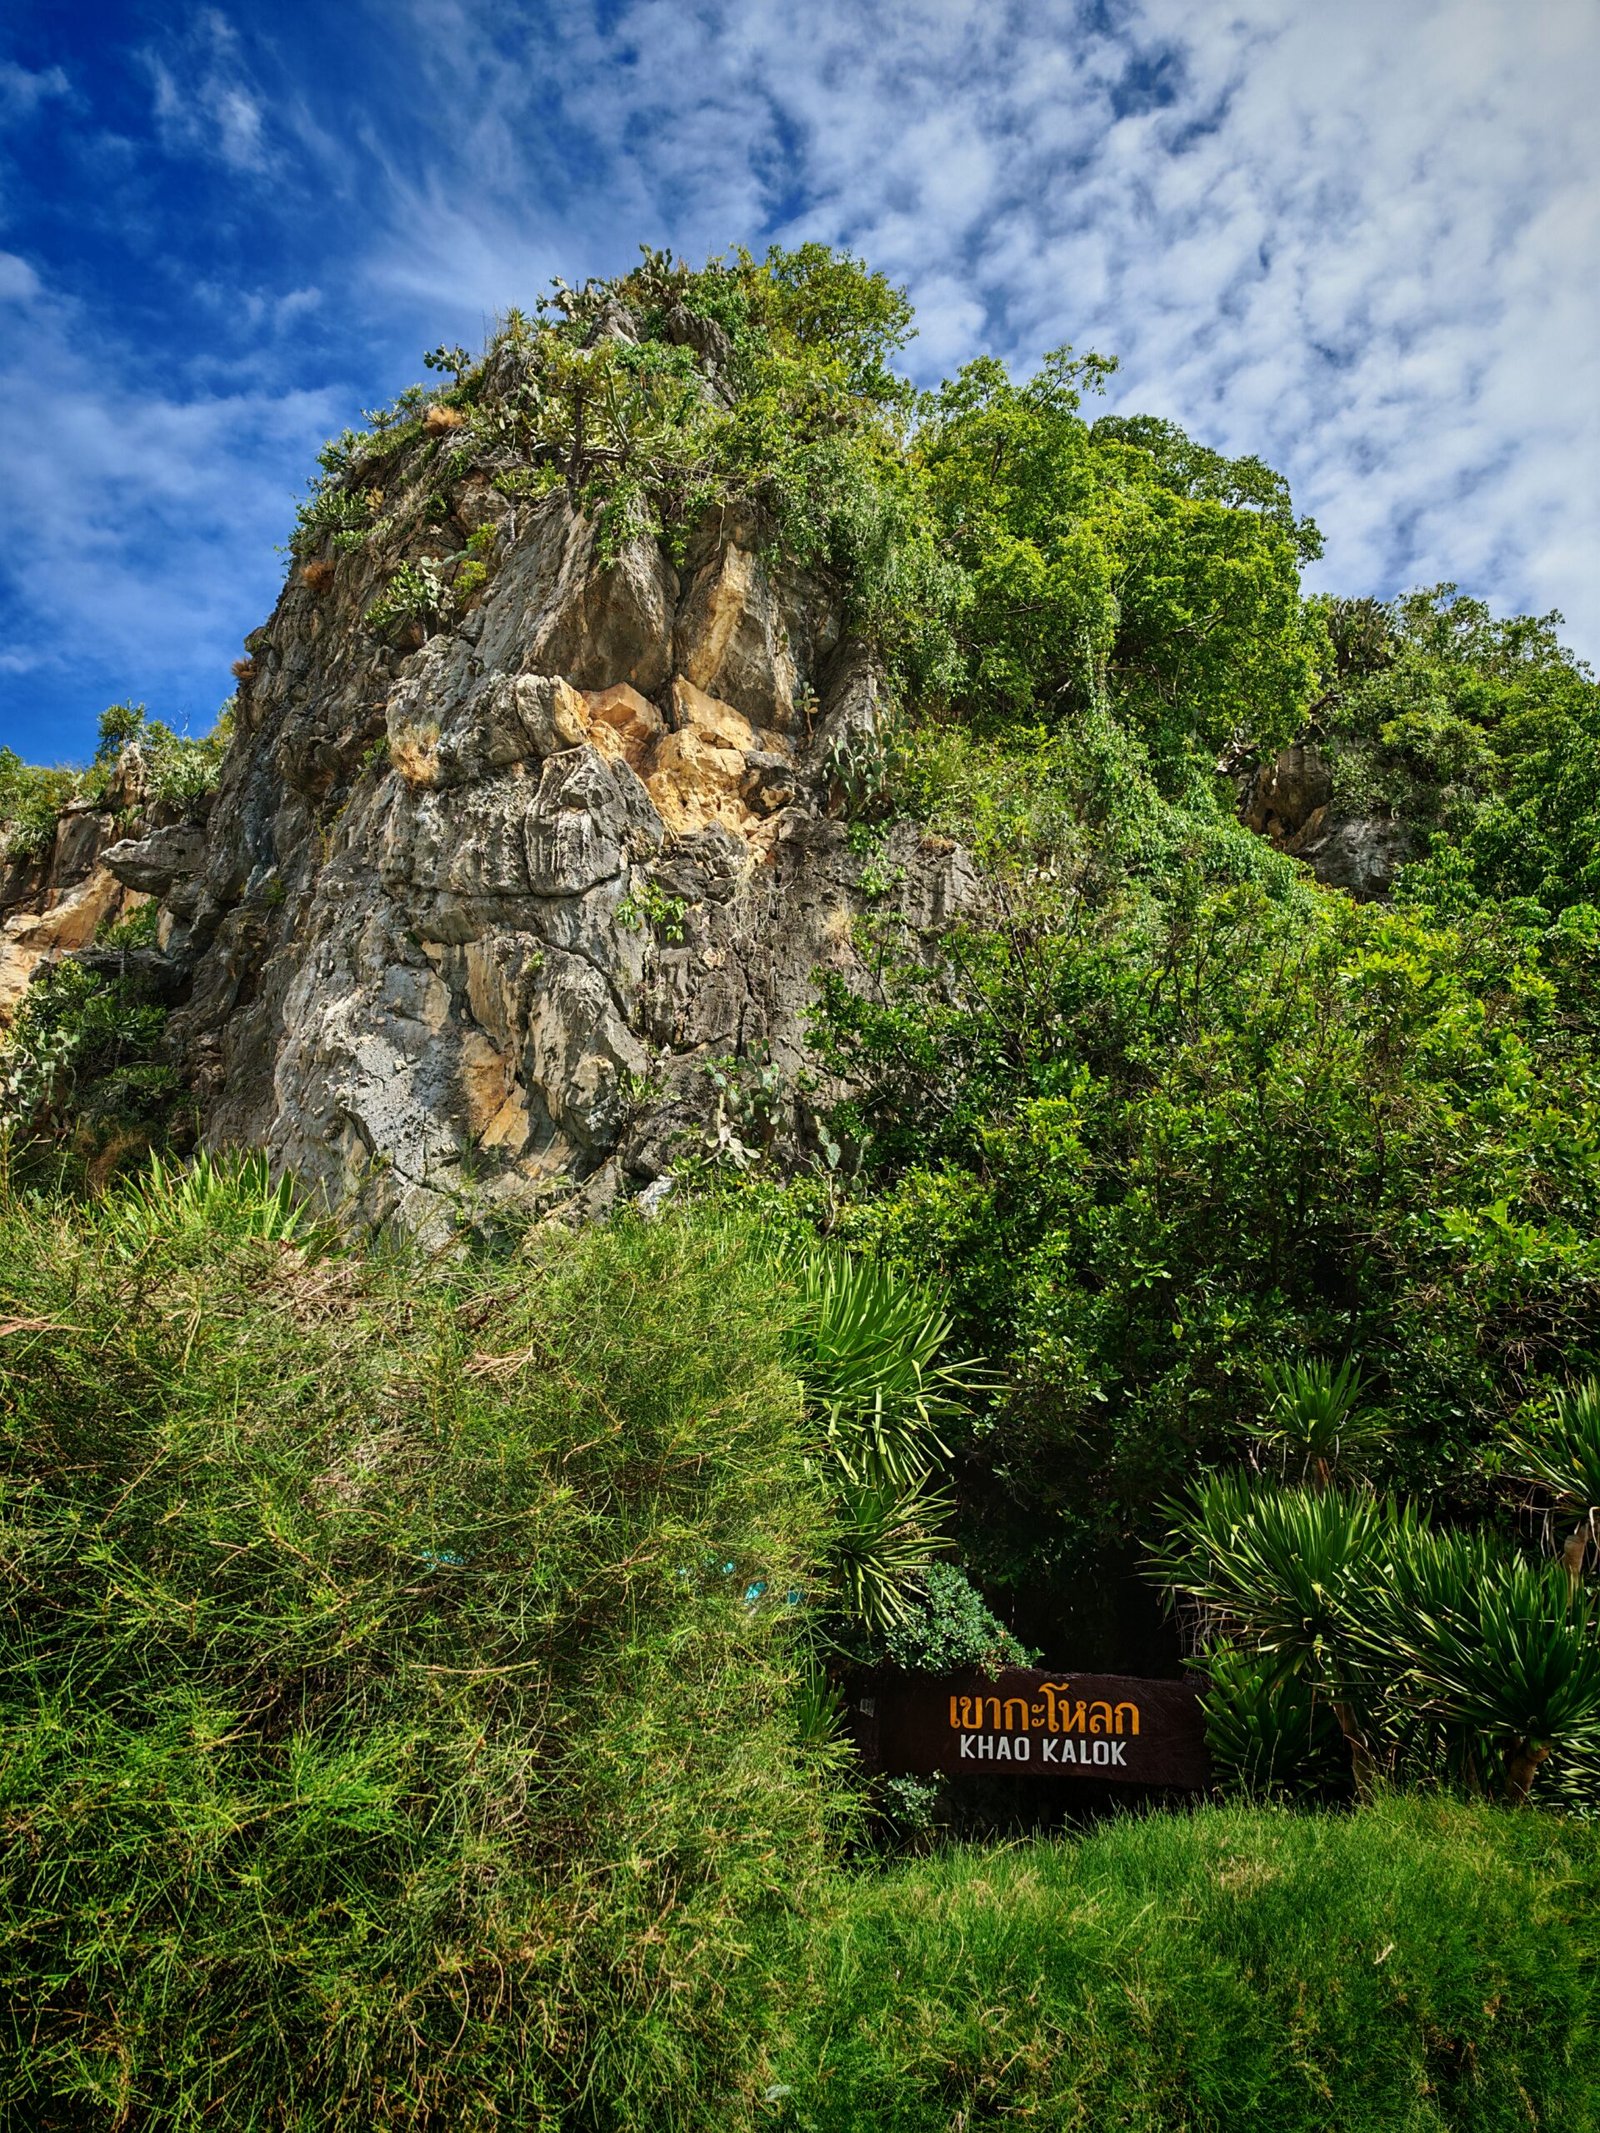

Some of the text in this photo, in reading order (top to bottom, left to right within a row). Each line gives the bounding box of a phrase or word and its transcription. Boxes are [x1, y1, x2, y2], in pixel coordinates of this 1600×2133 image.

[950, 1682, 1140, 1736] เขากะโหลก
[960, 1734, 1127, 1766] KHAO KALOK
